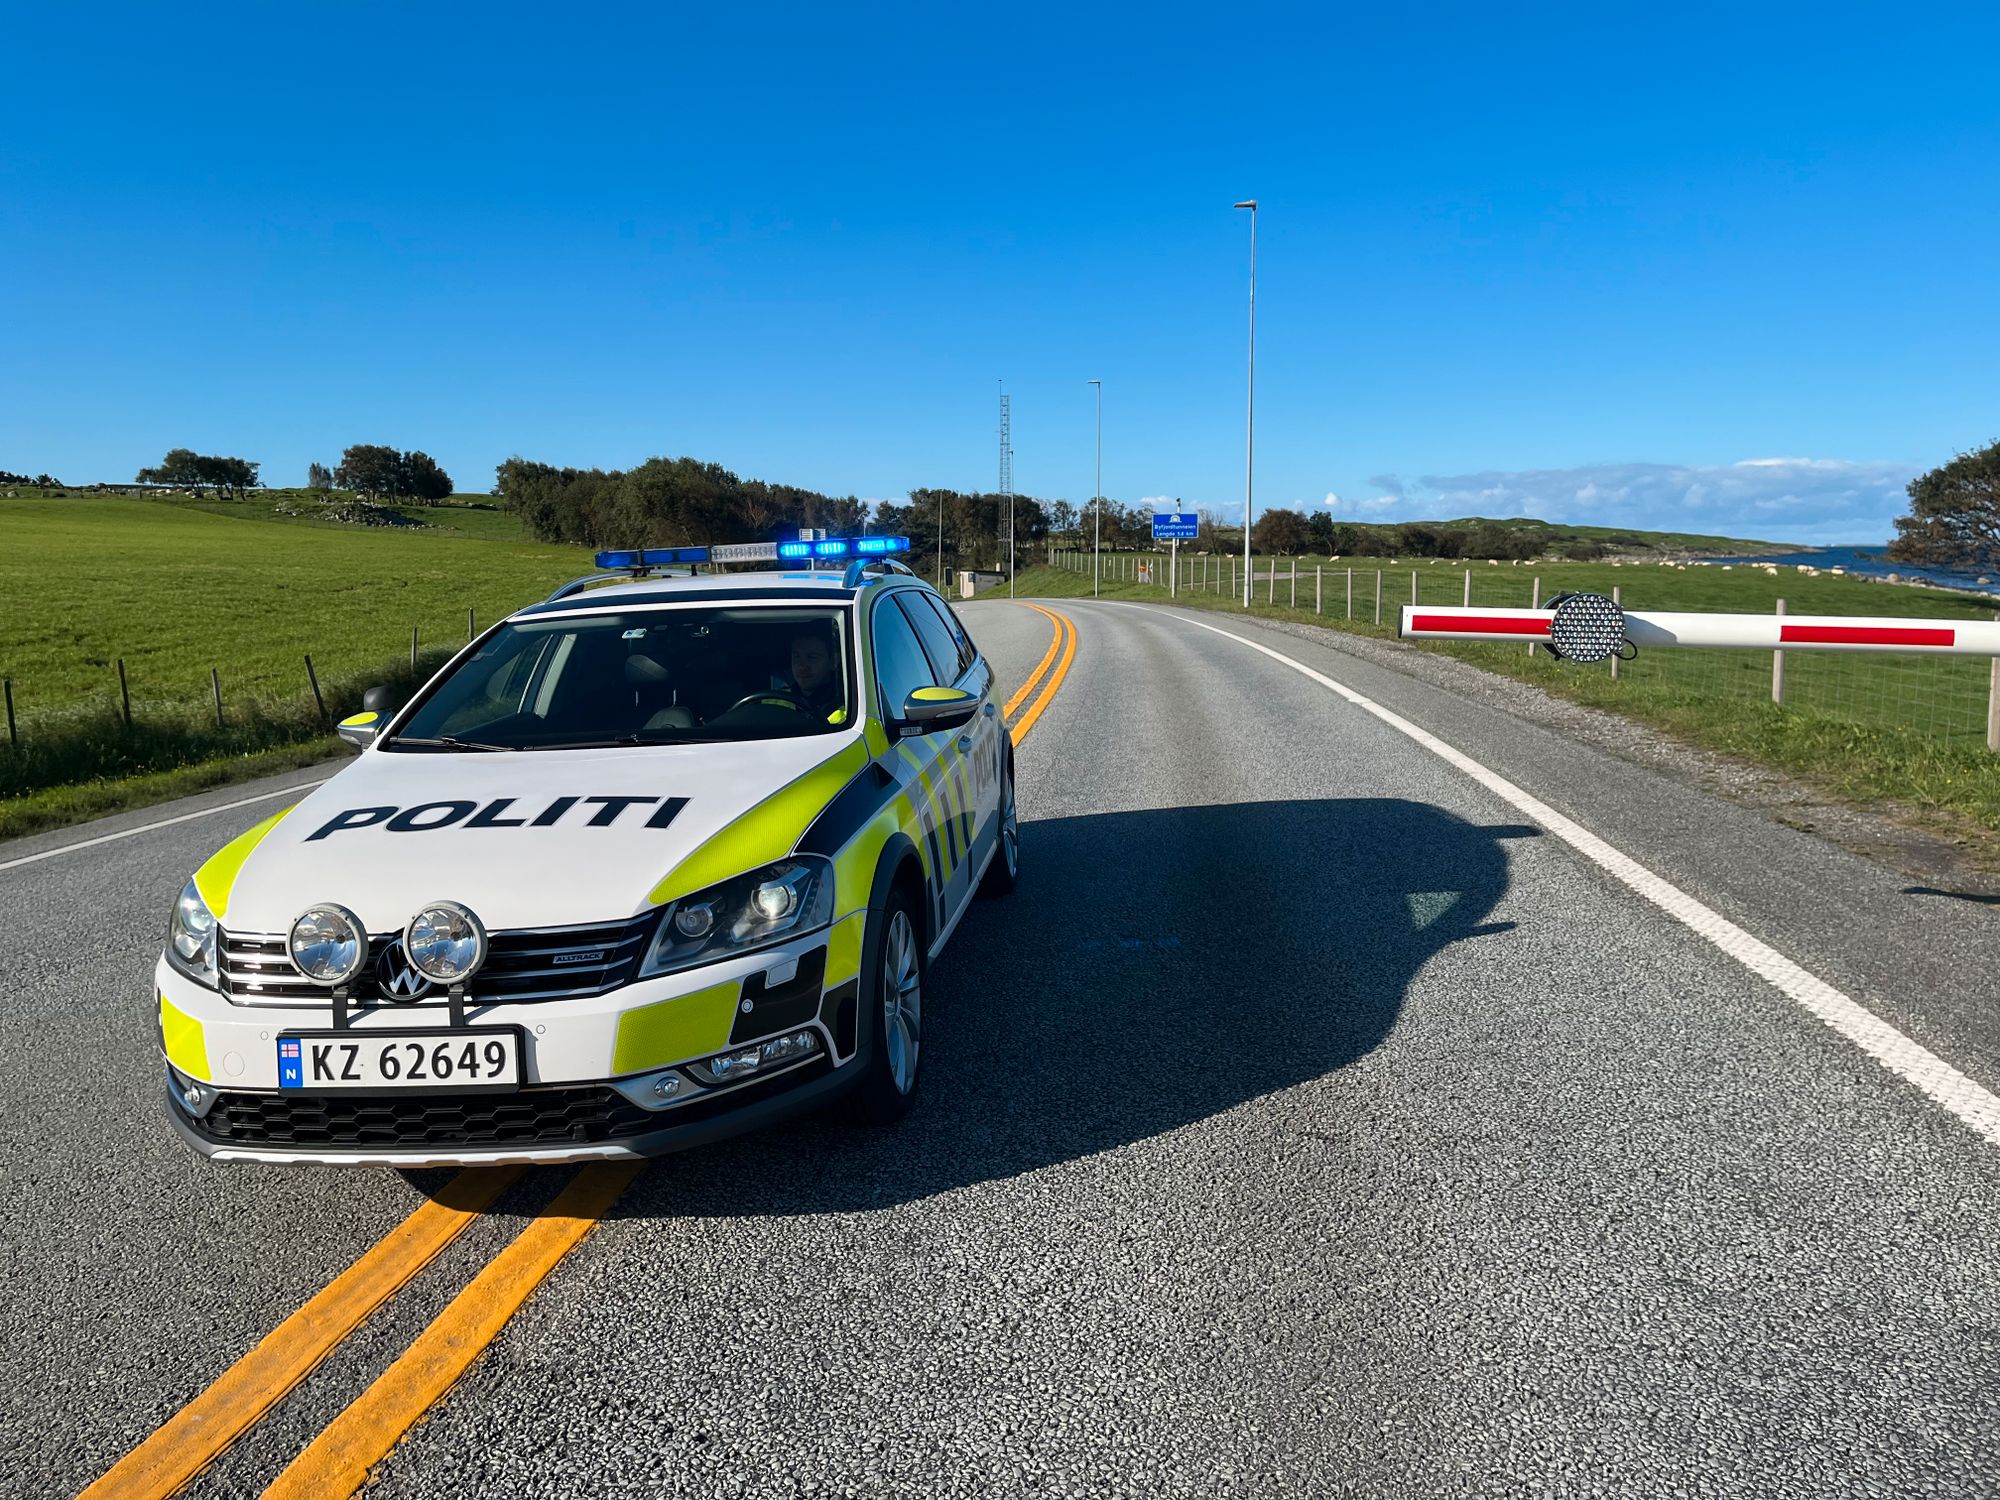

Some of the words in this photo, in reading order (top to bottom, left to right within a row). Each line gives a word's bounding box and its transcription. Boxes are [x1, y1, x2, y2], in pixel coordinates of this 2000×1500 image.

[303, 795, 692, 842] POLITI
[556, 952, 602, 962] ALLTRACK
[311, 1044, 361, 1081] KZ
[379, 1040, 507, 1081] 62649
[285, 1068, 297, 1080] N
